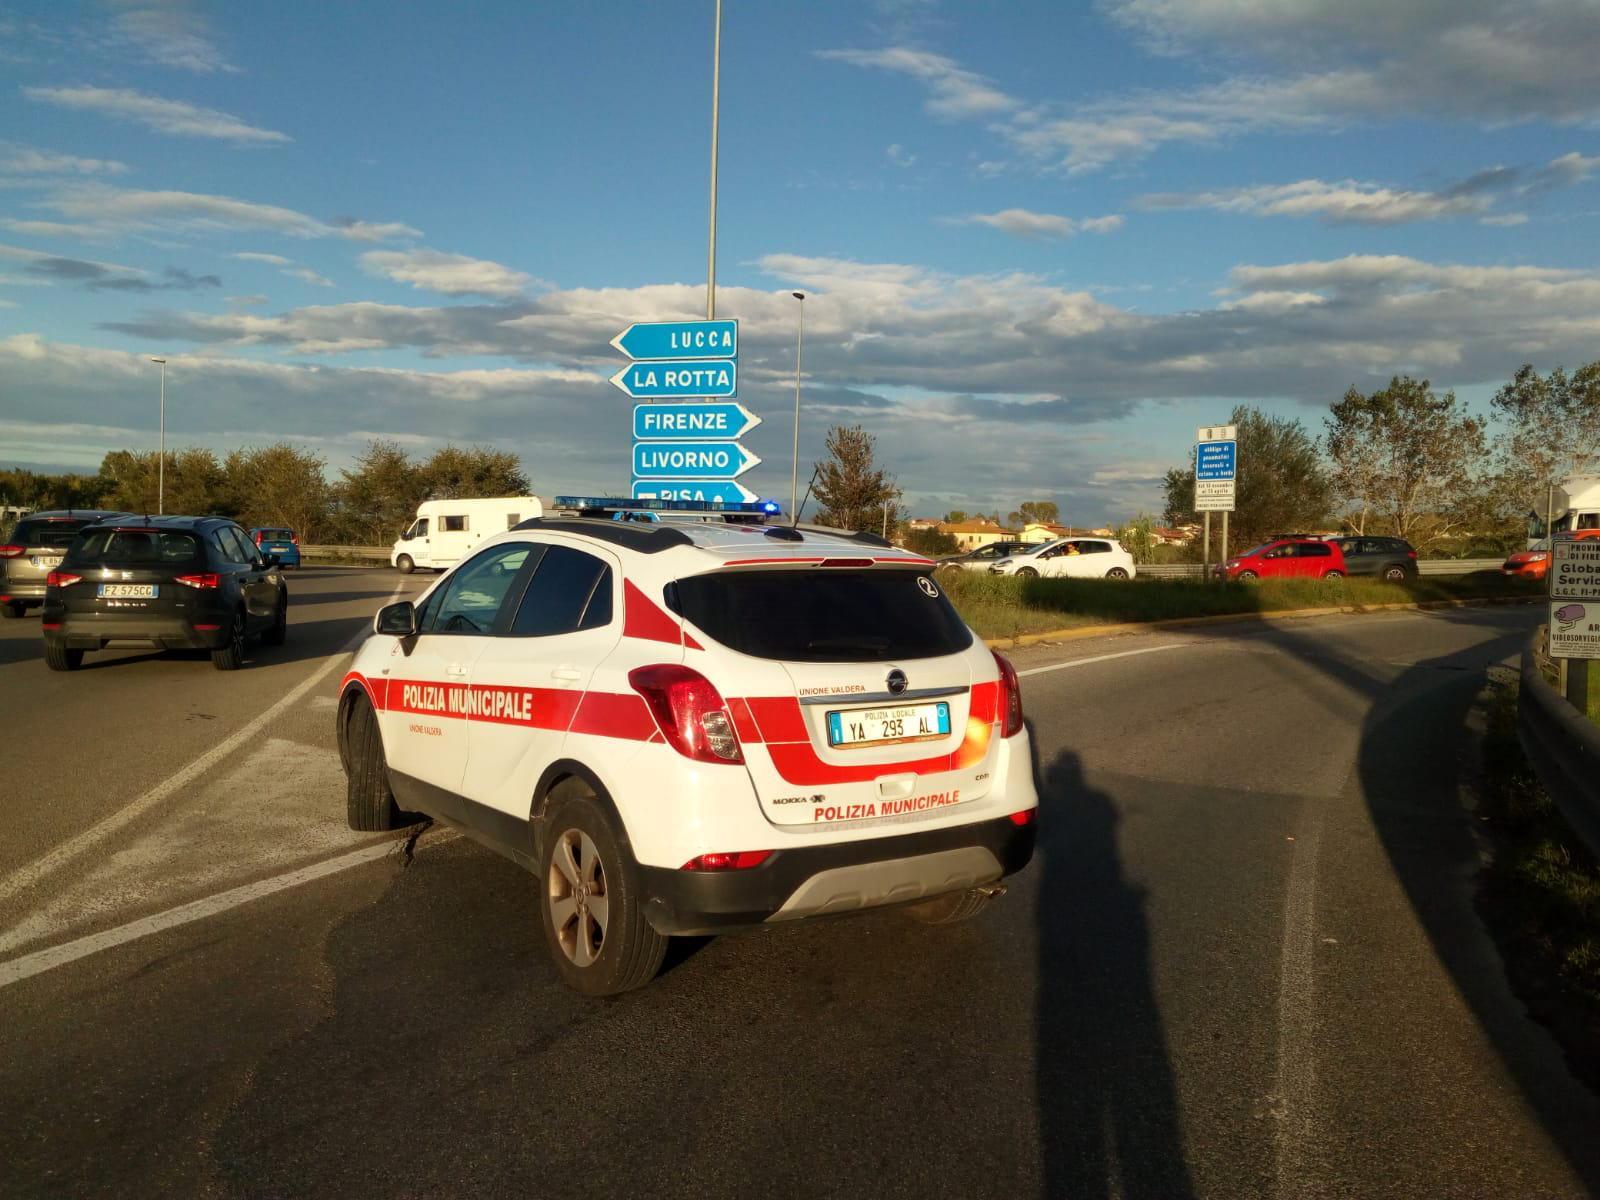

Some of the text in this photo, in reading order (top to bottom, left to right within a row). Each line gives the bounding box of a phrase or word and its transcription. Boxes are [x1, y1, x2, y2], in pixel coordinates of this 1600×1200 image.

[671, 331, 732, 349] LUCCA
[634, 370, 730, 388] LA ROTTA
[644, 413, 728, 430] FIRENZE
[641, 451, 729, 468] LIVORNO
[661, 490, 704, 501] PISA
[799, 685, 866, 695] UNIONE VALDERA
[403, 685, 533, 720] POLIZIA MUNICIPALE
[865, 709, 916, 720] POLIZIA LOCALE
[850, 716, 933, 741] YA 293 AL
[772, 797, 808, 805] MOKKA
[814, 790, 961, 822] POLIZIA MUNICIPALE
